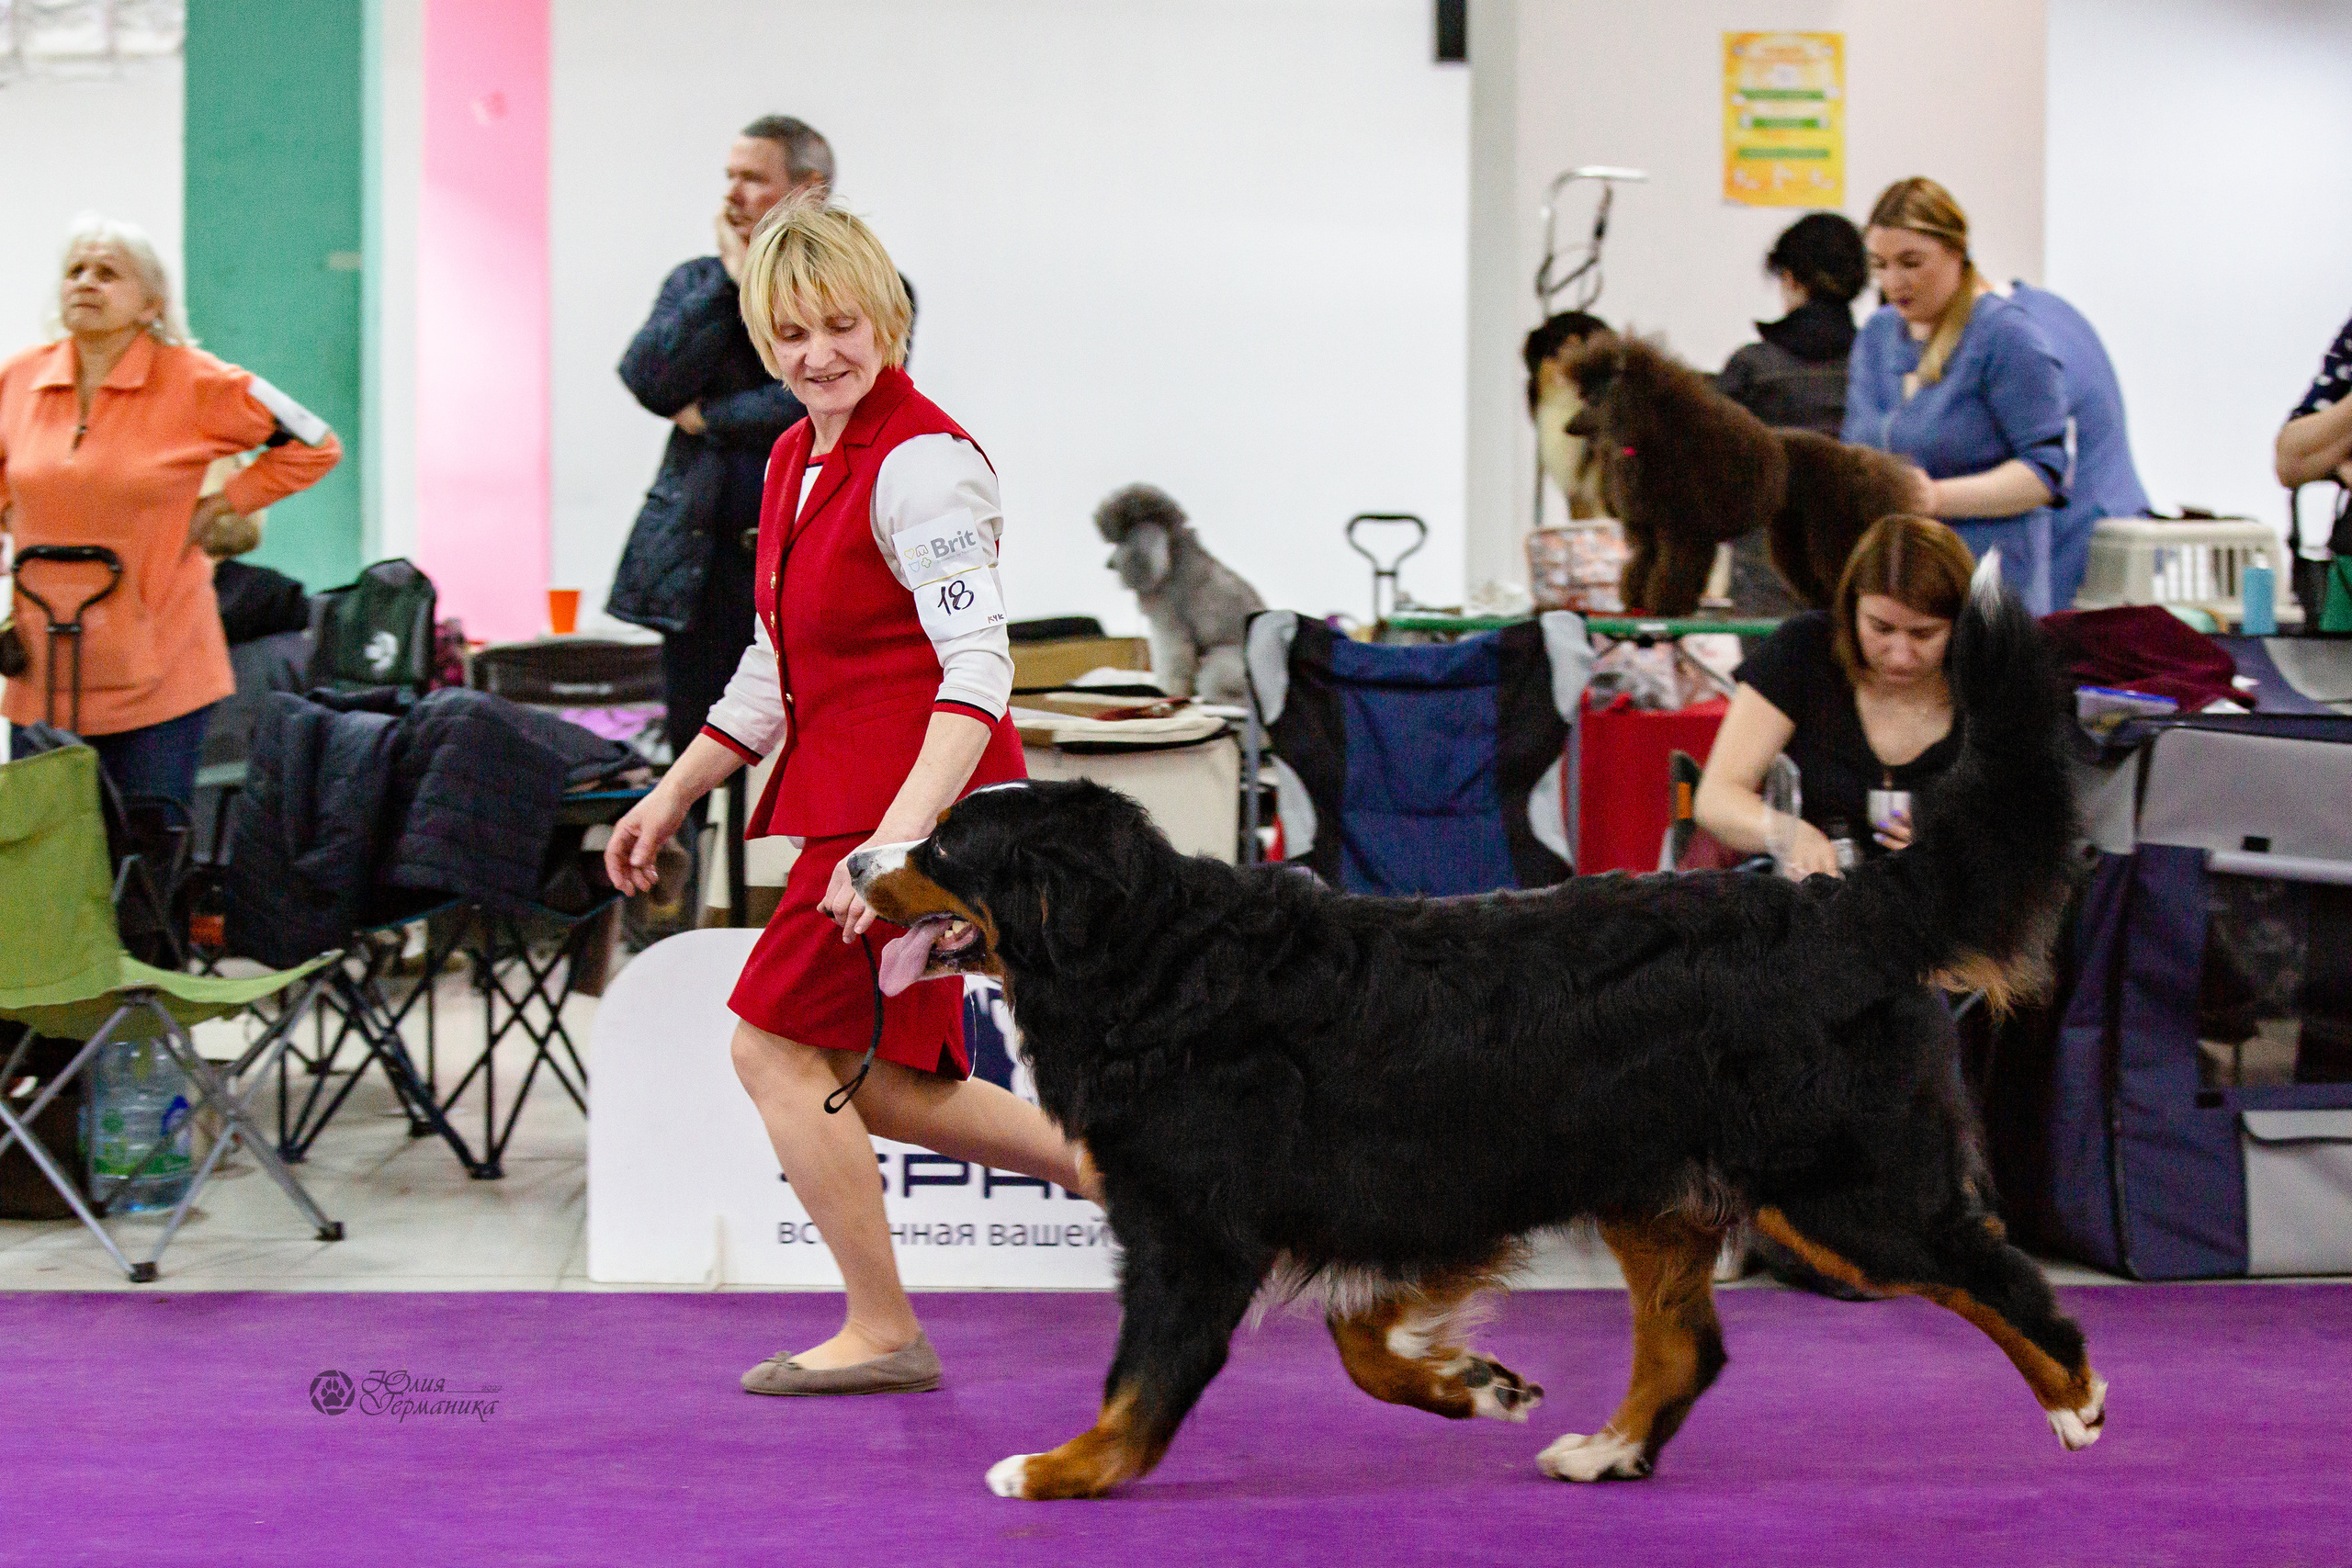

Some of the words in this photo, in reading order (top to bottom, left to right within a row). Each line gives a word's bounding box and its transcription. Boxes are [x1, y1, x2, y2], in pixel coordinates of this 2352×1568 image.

[931, 530, 976, 558] Brit
[937, 580, 975, 616] 18
[777, 1222, 977, 1247] вснная
[988, 1216, 1110, 1247] вашей
